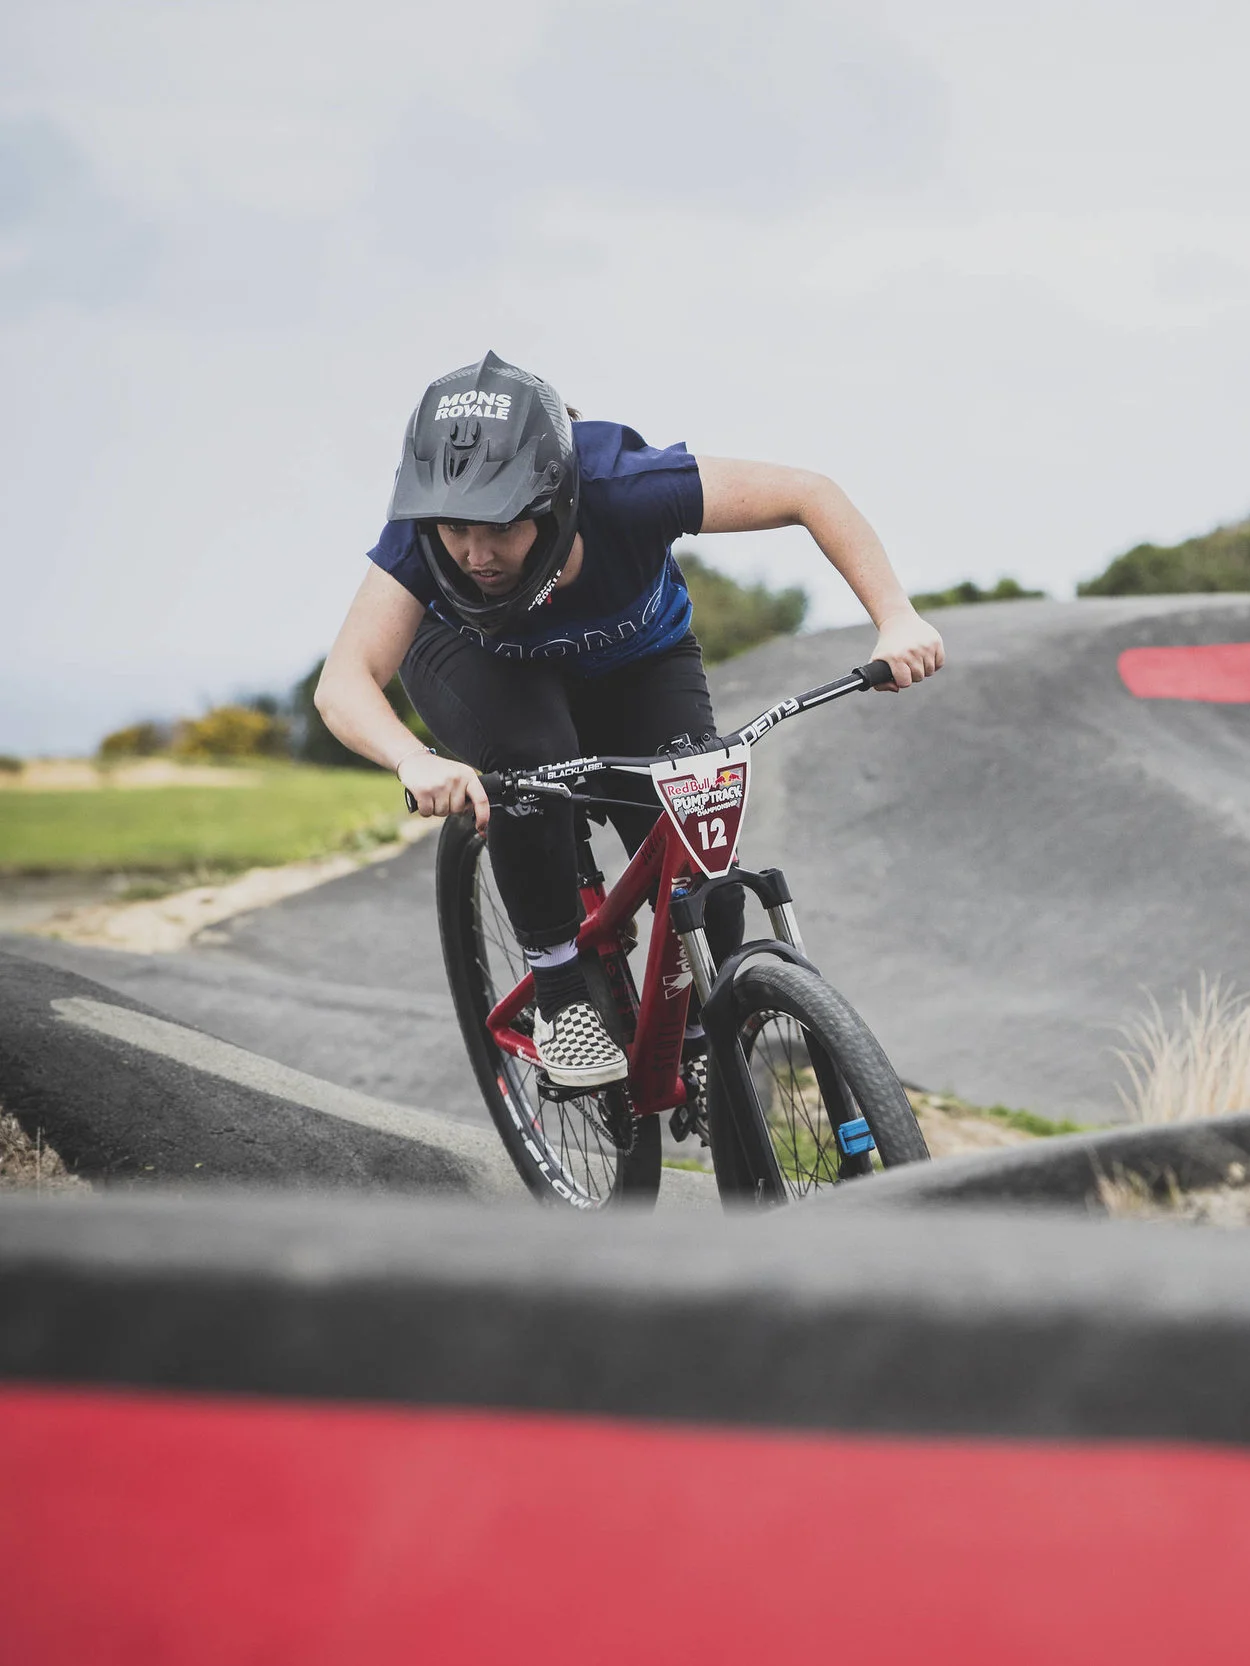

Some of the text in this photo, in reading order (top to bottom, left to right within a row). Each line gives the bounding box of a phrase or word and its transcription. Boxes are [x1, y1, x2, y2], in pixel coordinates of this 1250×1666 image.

[437, 390, 512, 408] MONS
[434, 404, 510, 421] ROYALE
[738, 697, 800, 746] DEITY
[547, 762, 607, 780] BLACKLABEL
[667, 777, 711, 796] Red Bull
[684, 805, 705, 815] WORLD
[698, 817, 727, 850] 12
